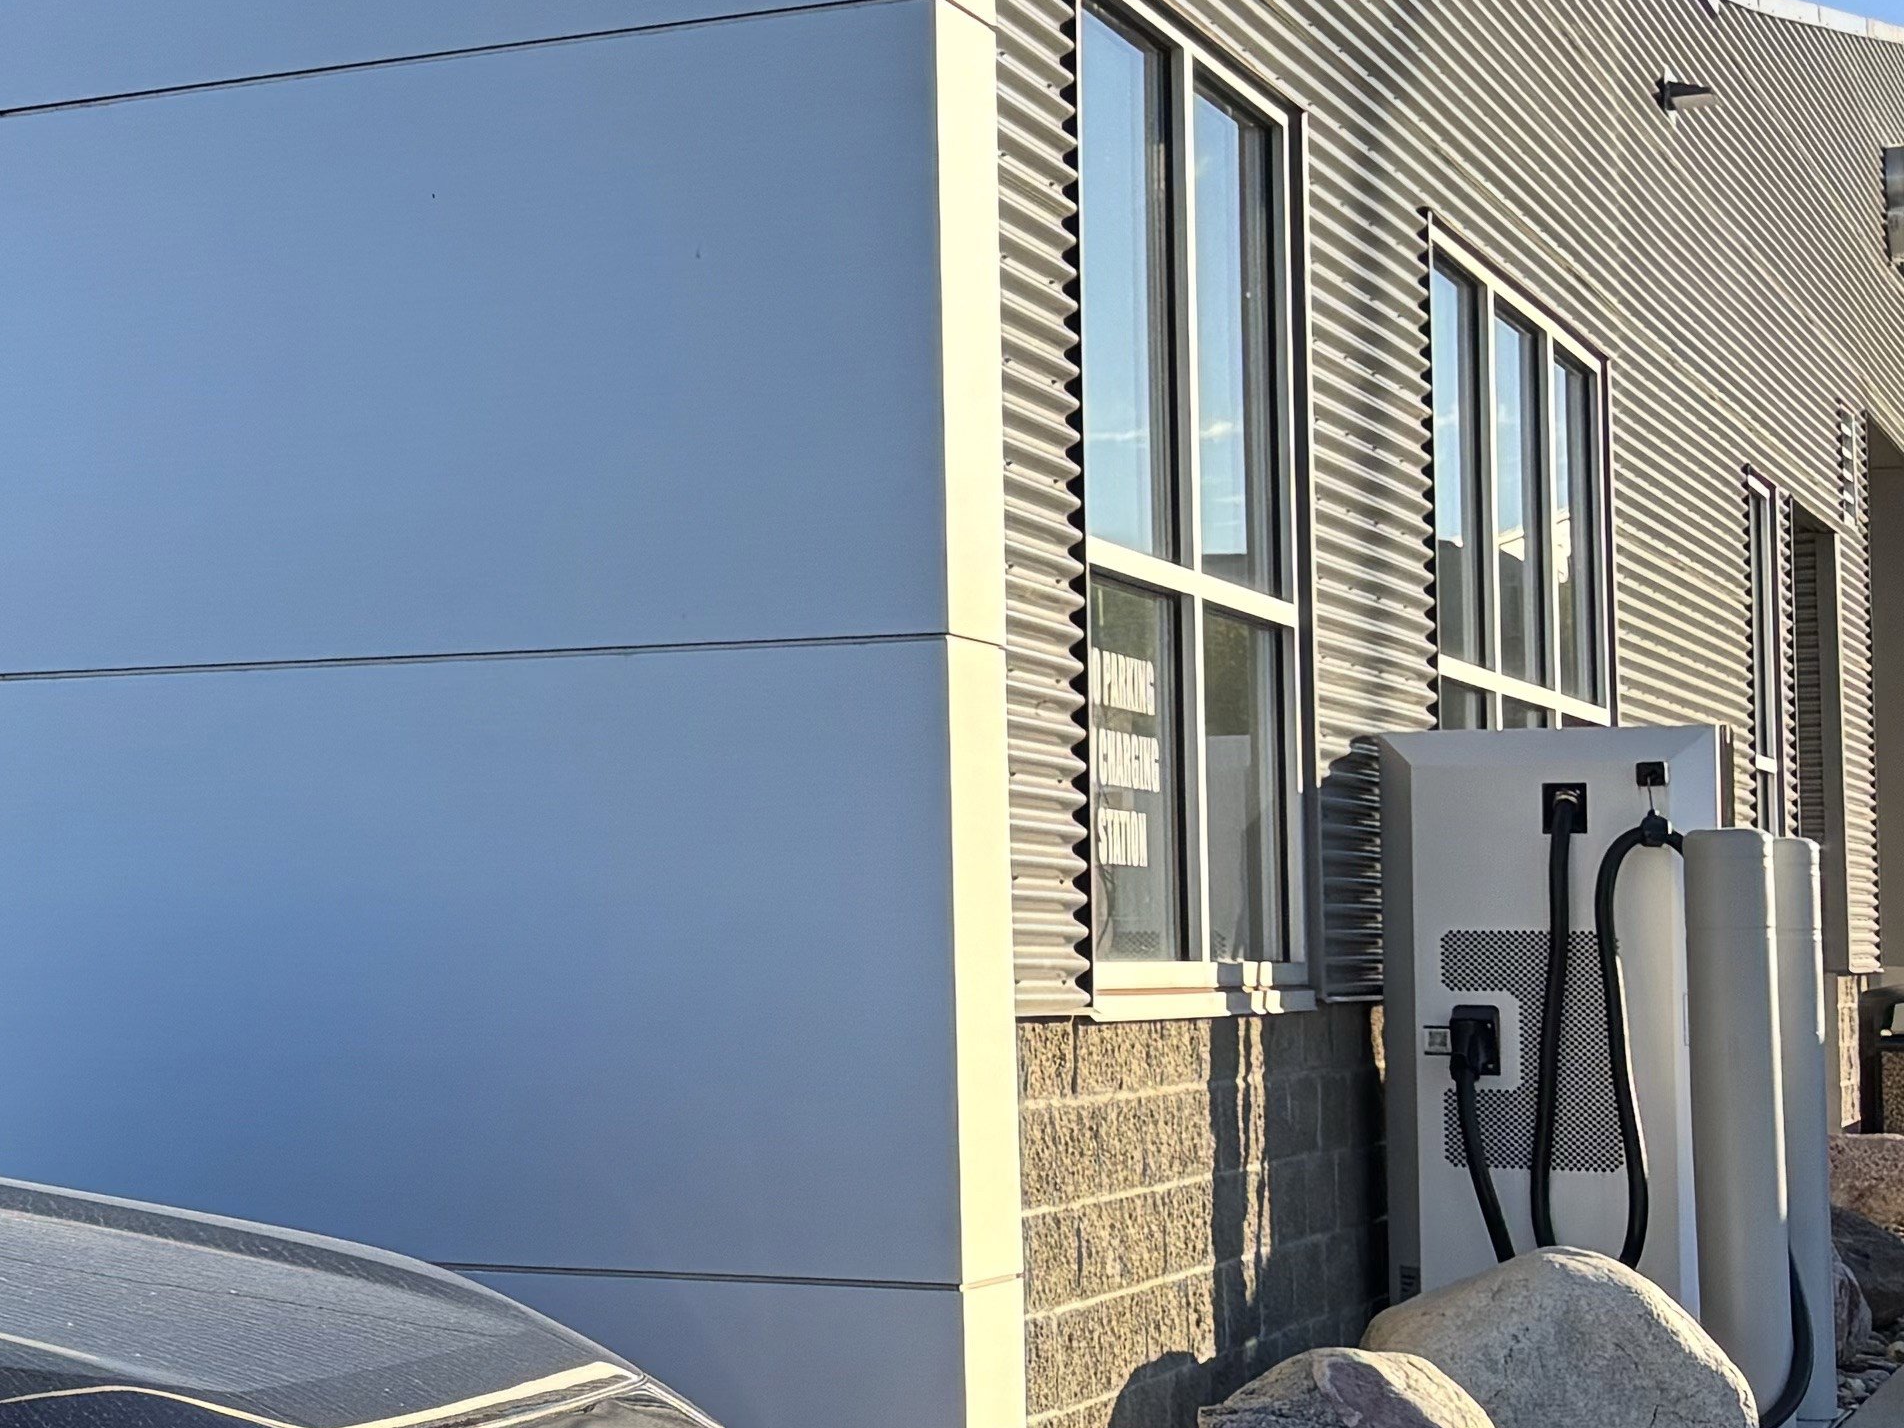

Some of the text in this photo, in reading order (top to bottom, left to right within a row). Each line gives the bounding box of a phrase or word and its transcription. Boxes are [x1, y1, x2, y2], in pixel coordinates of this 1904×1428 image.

[1102, 649, 1155, 716] PARKING
[1098, 728, 1160, 793] CHARGING
[1097, 807, 1148, 867] STATION
